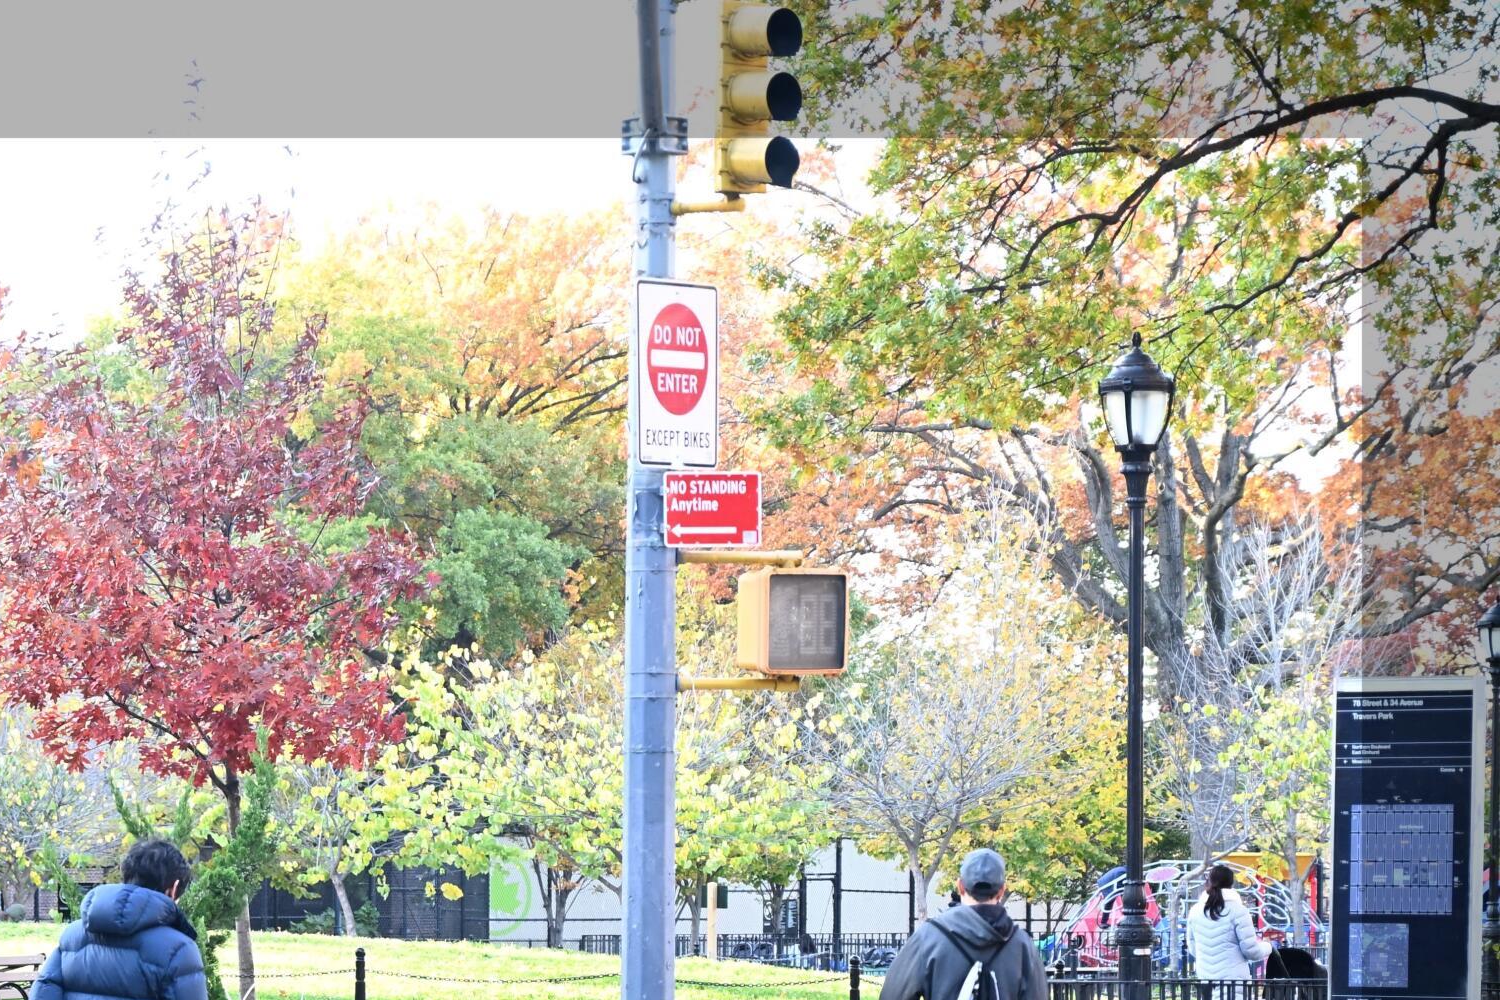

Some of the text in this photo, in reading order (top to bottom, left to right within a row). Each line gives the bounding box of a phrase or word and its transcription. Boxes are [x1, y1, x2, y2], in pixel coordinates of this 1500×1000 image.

[654, 325, 701, 347] DO NOT
[657, 372, 698, 394] ENTER
[646, 429, 710, 448] EXCEPT BIKES
[669, 480, 746, 494] NO STANDING
[671, 498, 718, 513] Anytime
